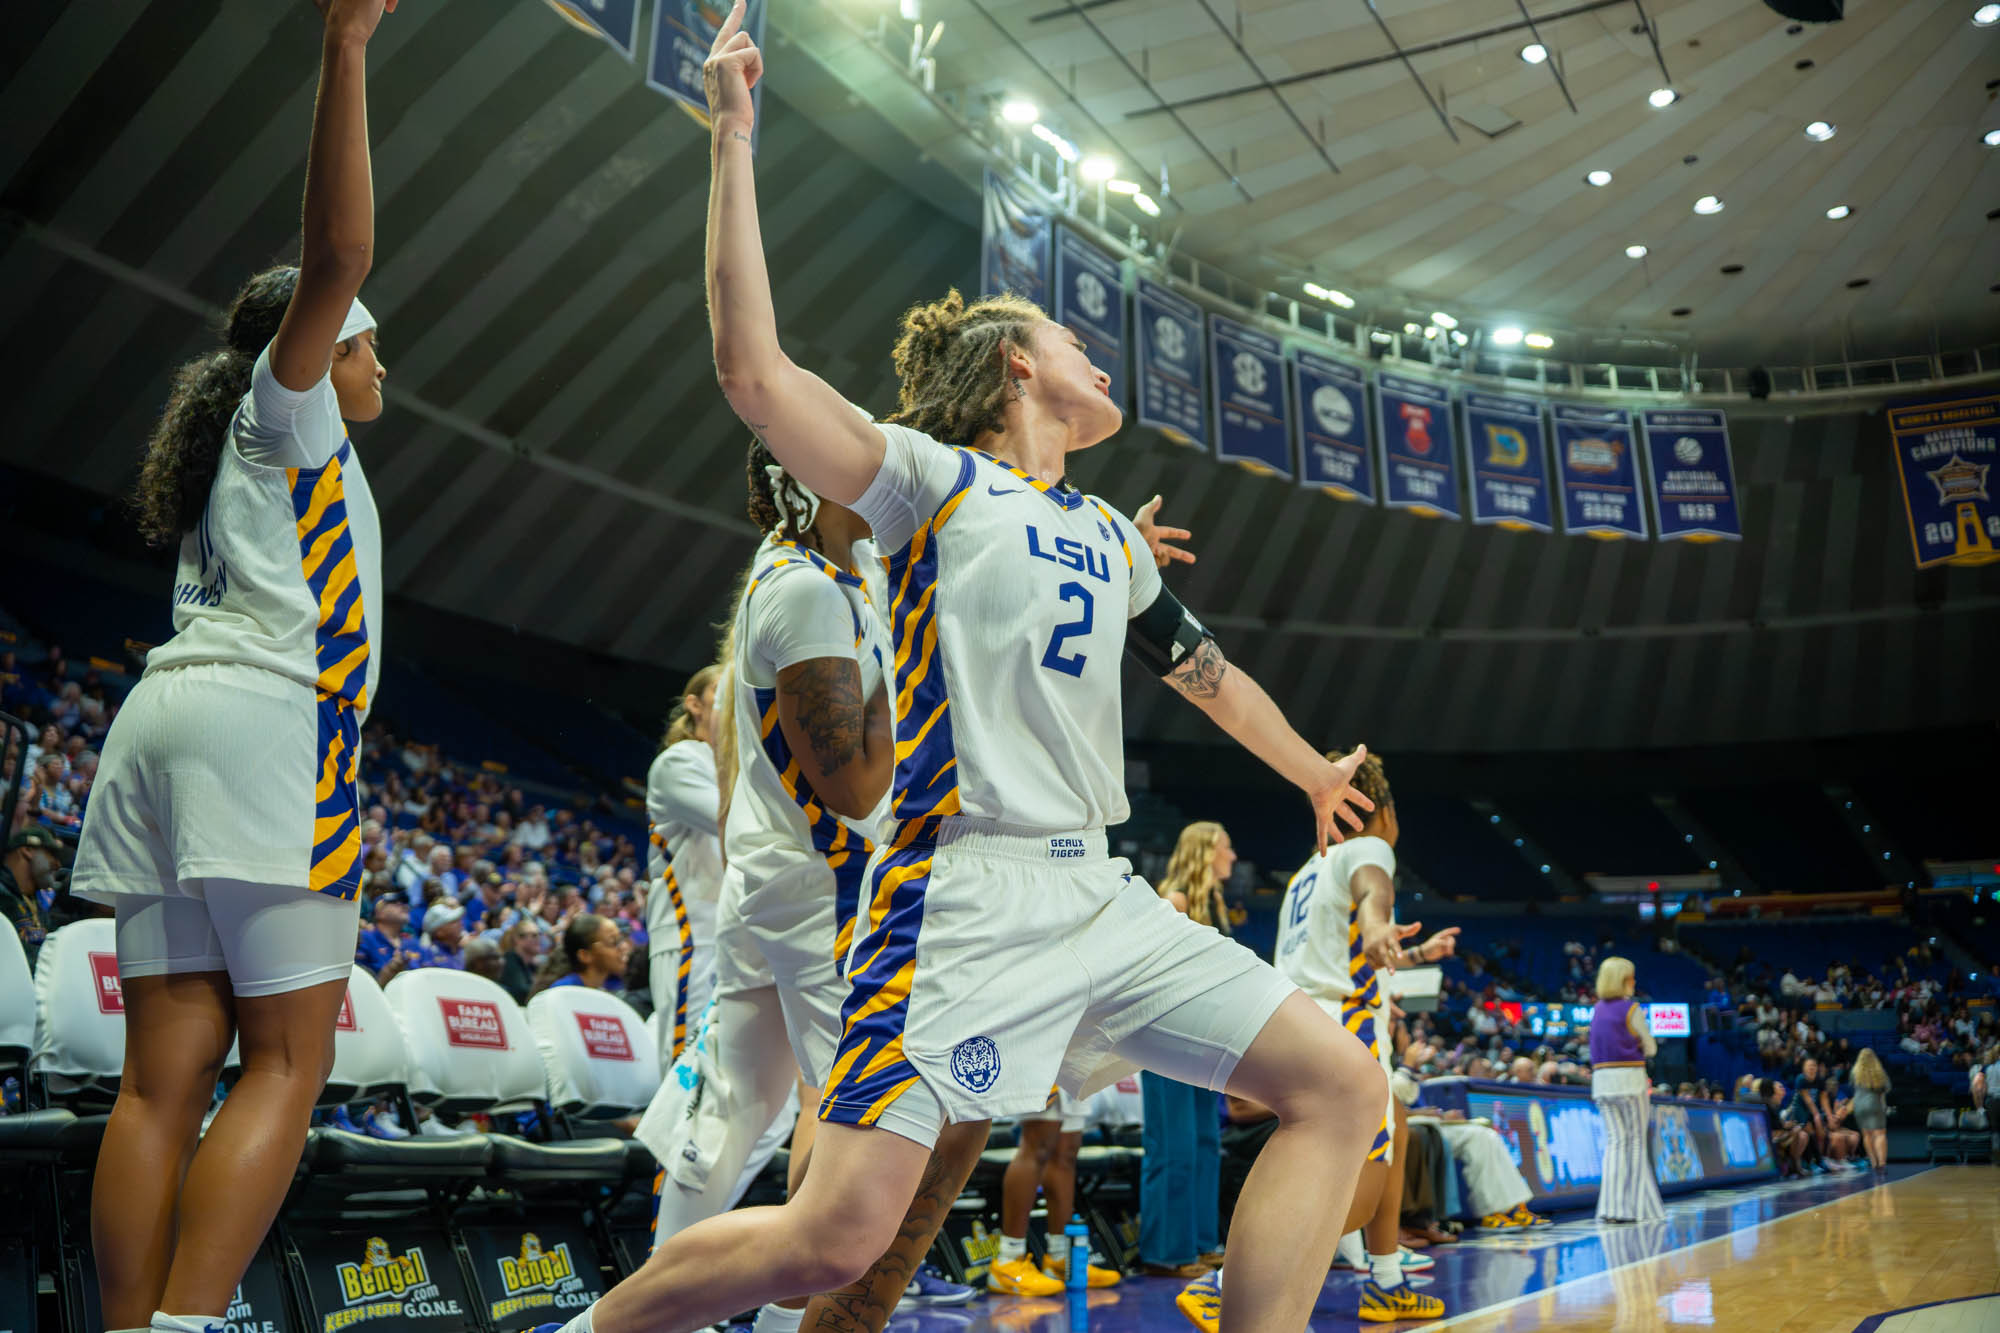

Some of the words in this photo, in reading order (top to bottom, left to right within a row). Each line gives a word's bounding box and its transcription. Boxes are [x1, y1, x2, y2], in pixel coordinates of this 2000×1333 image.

[1924, 428, 1976, 443] NATIONAL
[1911, 436, 1996, 461] CHAMPIONS
[1924, 521, 1954, 545] 20
[1026, 524, 1110, 583] LSU
[1041, 581, 1094, 678] 2
[1049, 848, 1085, 858] TIGERS
[1050, 838, 1084, 848] GEAUX
[1290, 873, 1318, 929] 12
[457, 1004, 495, 1018] FARM
[448, 1016, 498, 1031] BUREAU
[340, 1251, 427, 1299] Bengal
[502, 1246, 572, 1291] Bengal
[324, 1306, 366, 1333] KEEPS
[367, 1302, 402, 1318] PESTS
[404, 1299, 463, 1318] G.O.N.E.
